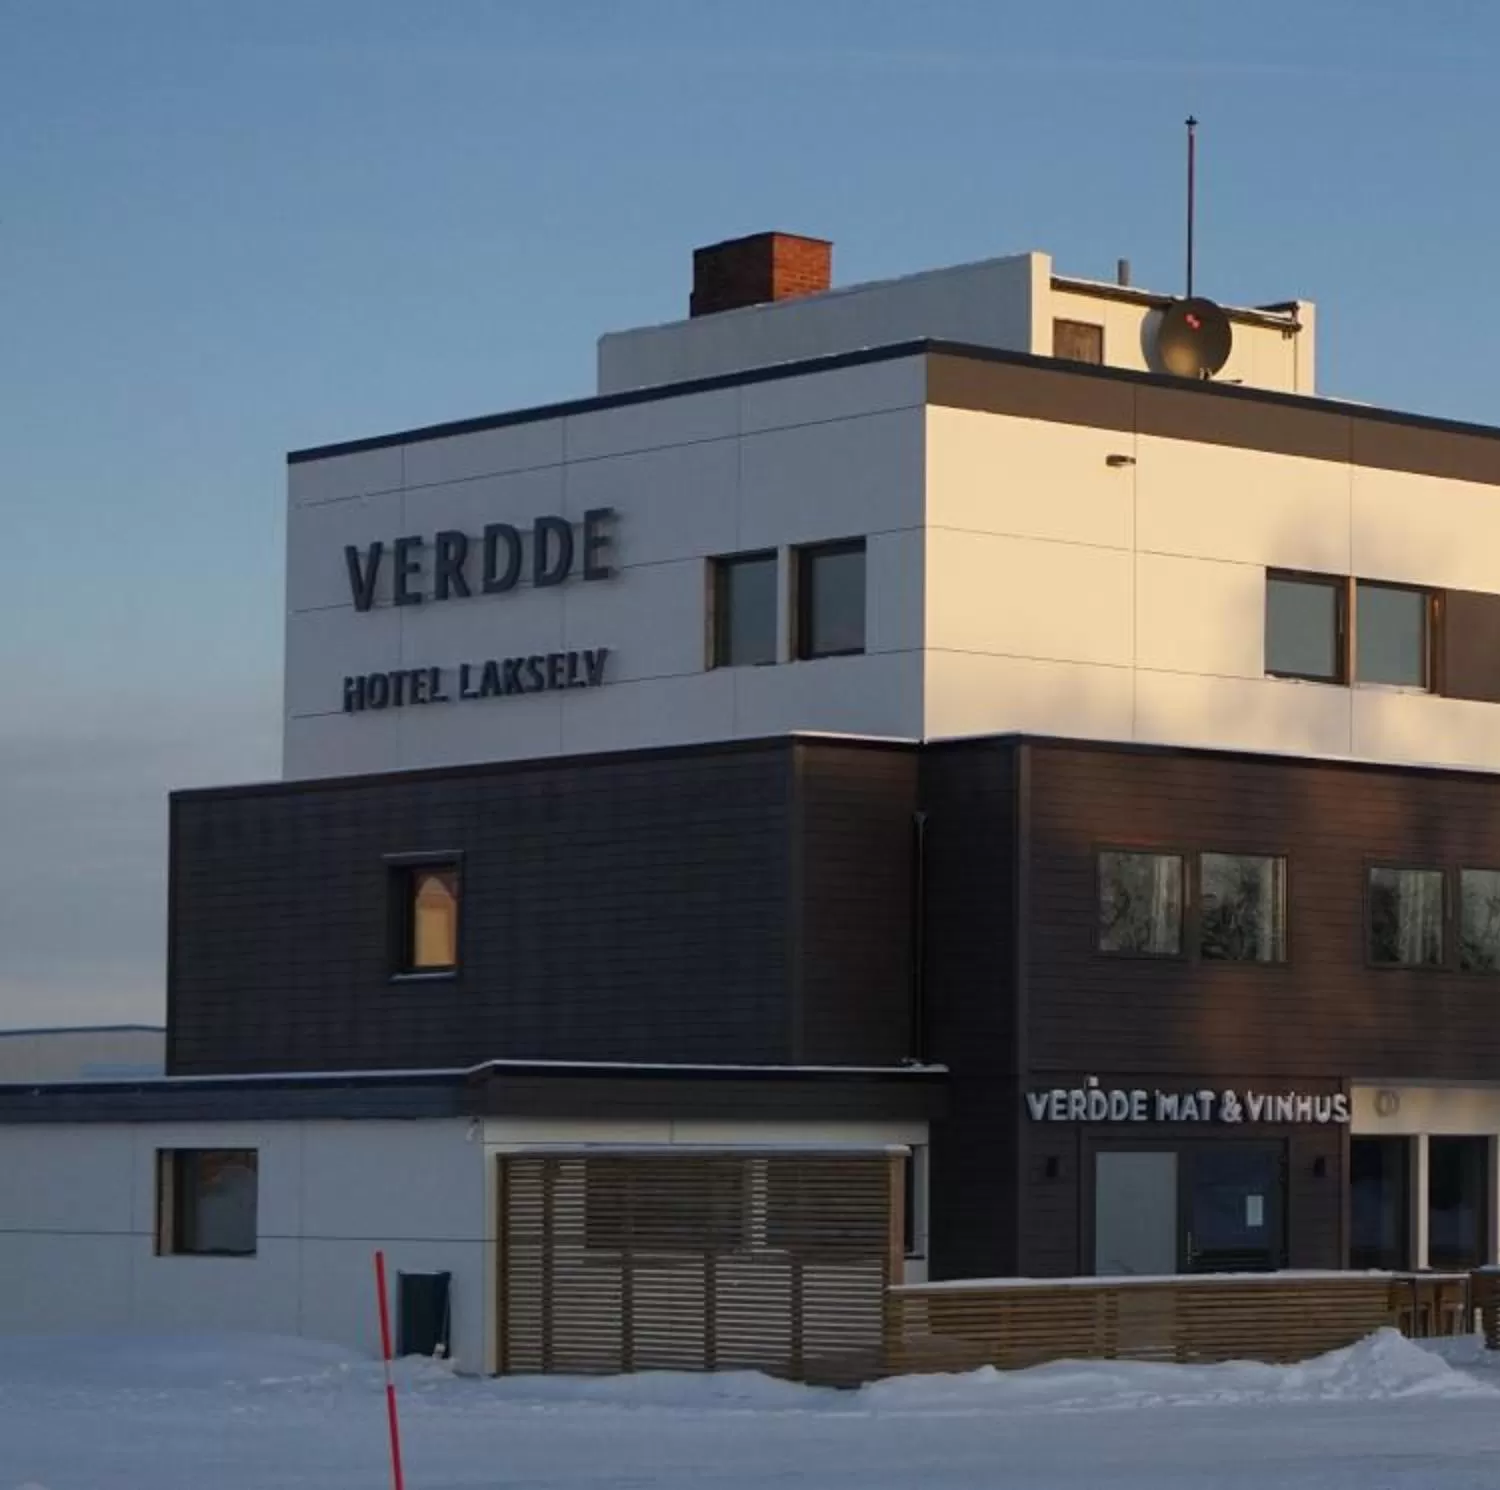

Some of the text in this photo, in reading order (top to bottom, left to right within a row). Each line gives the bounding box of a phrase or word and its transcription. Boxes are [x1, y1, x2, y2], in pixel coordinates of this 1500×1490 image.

[345, 507, 616, 612] VERDDE
[343, 648, 609, 713] HOTEL LAKSELV
[1027, 1089, 1350, 1122] VERDDE MAT & VINHUS
